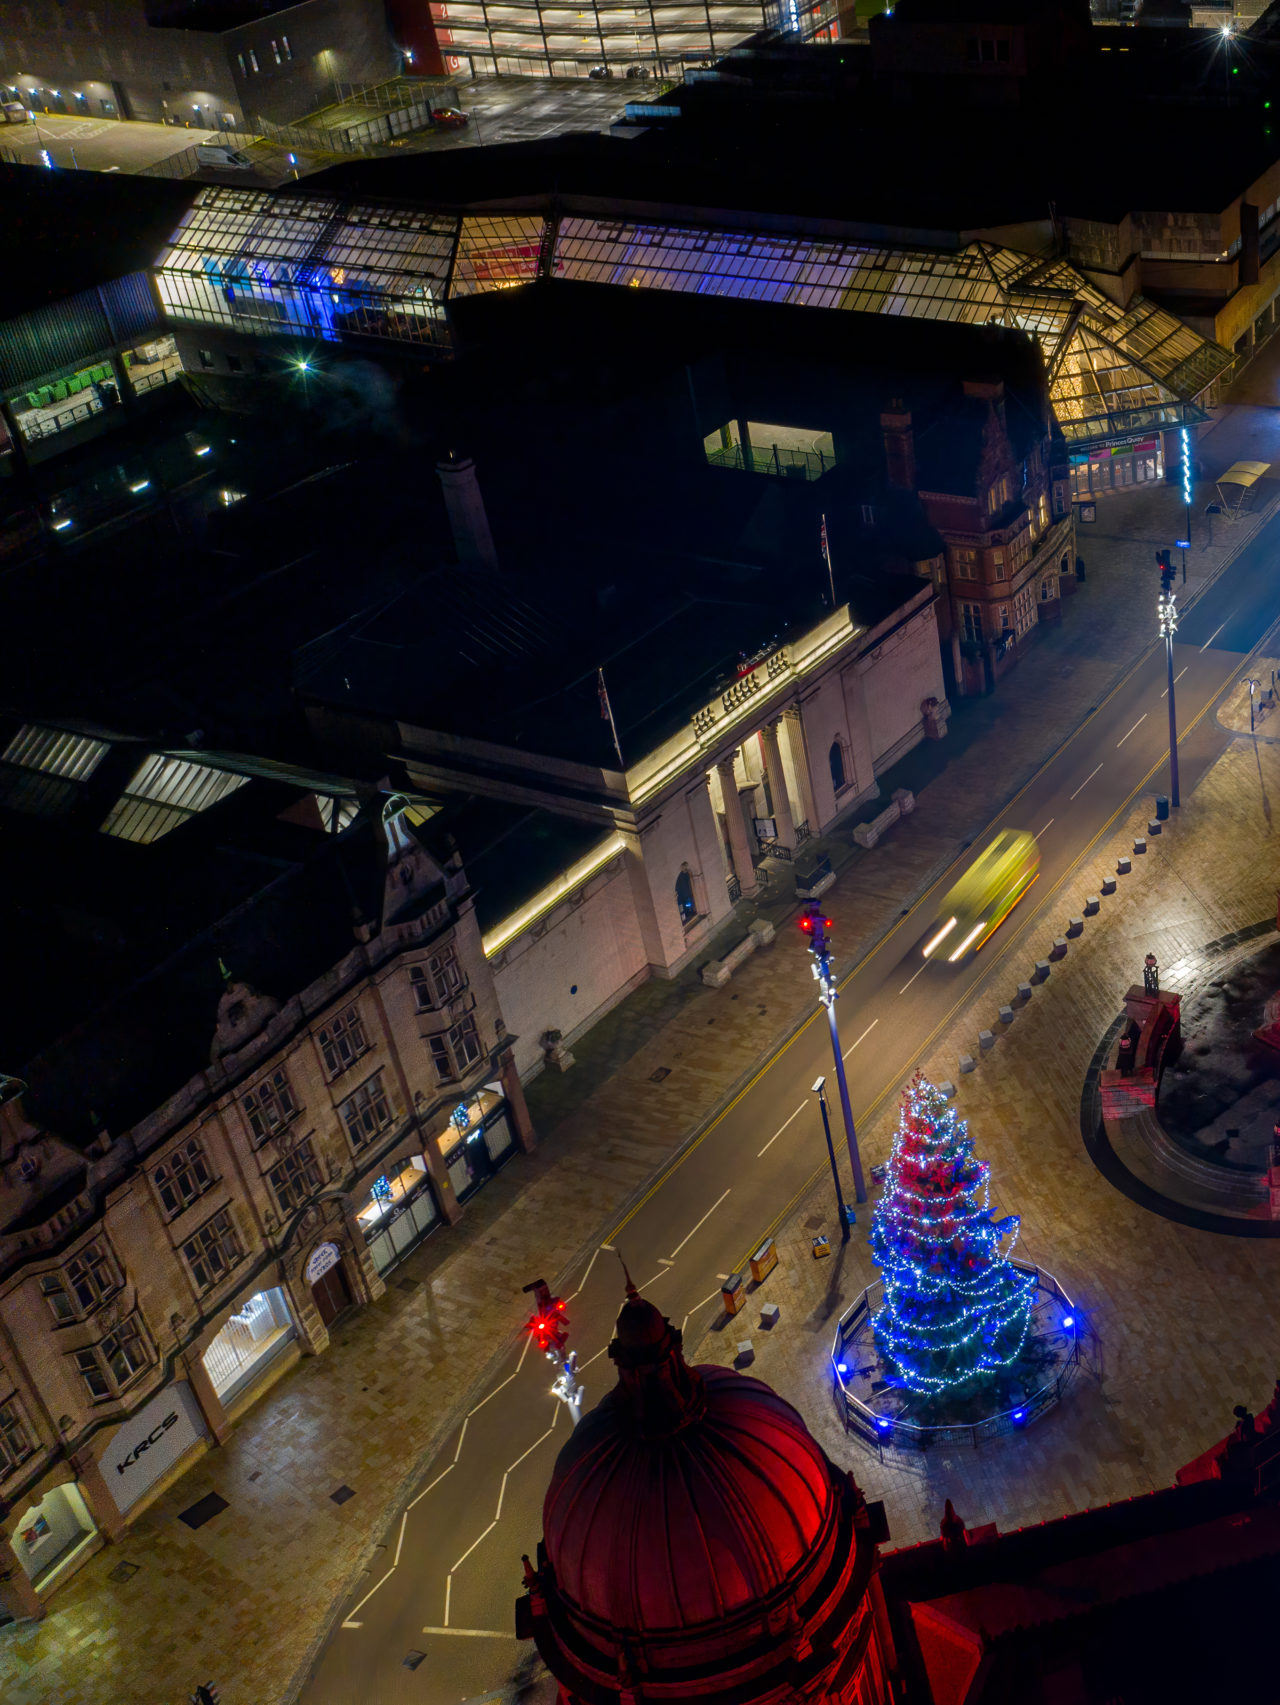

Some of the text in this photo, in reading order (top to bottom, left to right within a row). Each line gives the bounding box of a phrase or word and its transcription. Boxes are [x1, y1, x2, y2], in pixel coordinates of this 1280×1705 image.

[440, 3, 448, 19] 2
[447, 28, 453, 42] 1
[450, 56, 458, 69] G
[1105, 439, 1127, 448] Princes
[117, 1411, 179, 1475] KRCS
